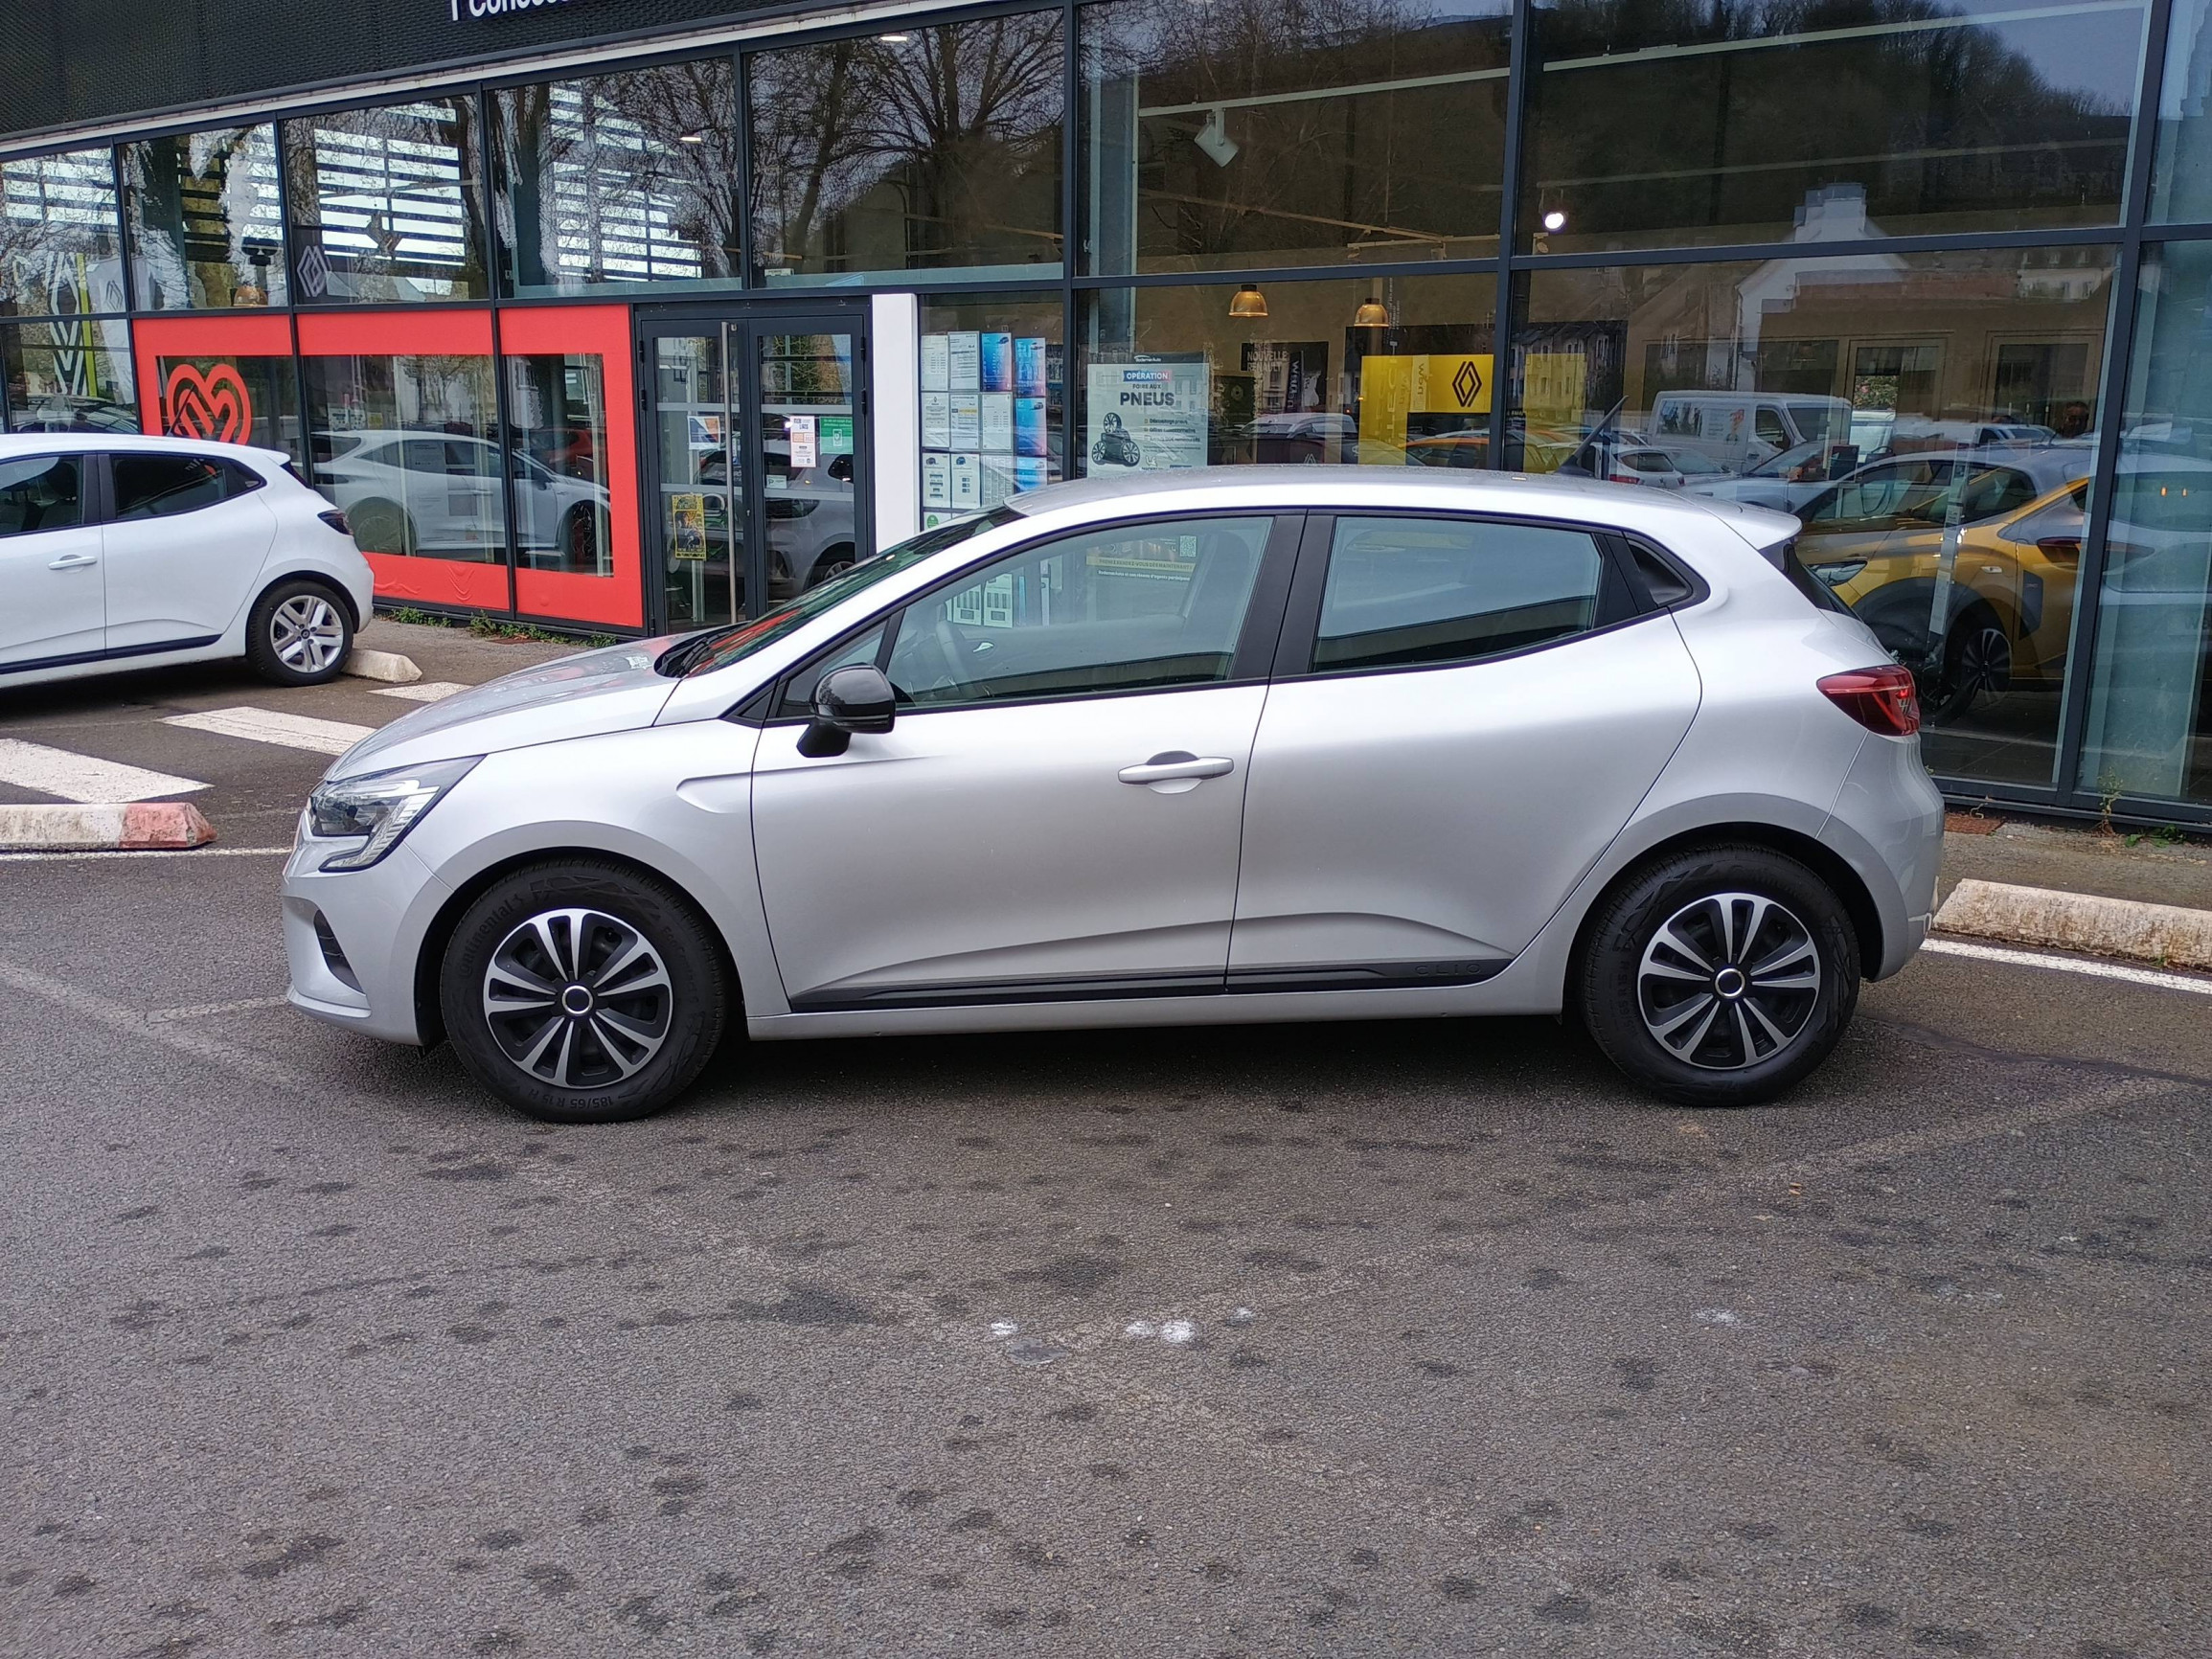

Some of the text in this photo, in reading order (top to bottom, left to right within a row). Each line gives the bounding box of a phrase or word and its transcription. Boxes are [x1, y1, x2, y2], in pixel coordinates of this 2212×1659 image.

[1126, 371, 1169, 380] OPÉRATION
[1120, 392, 1175, 406] PNEUS
[570, 1095, 614, 1110] 185/65
